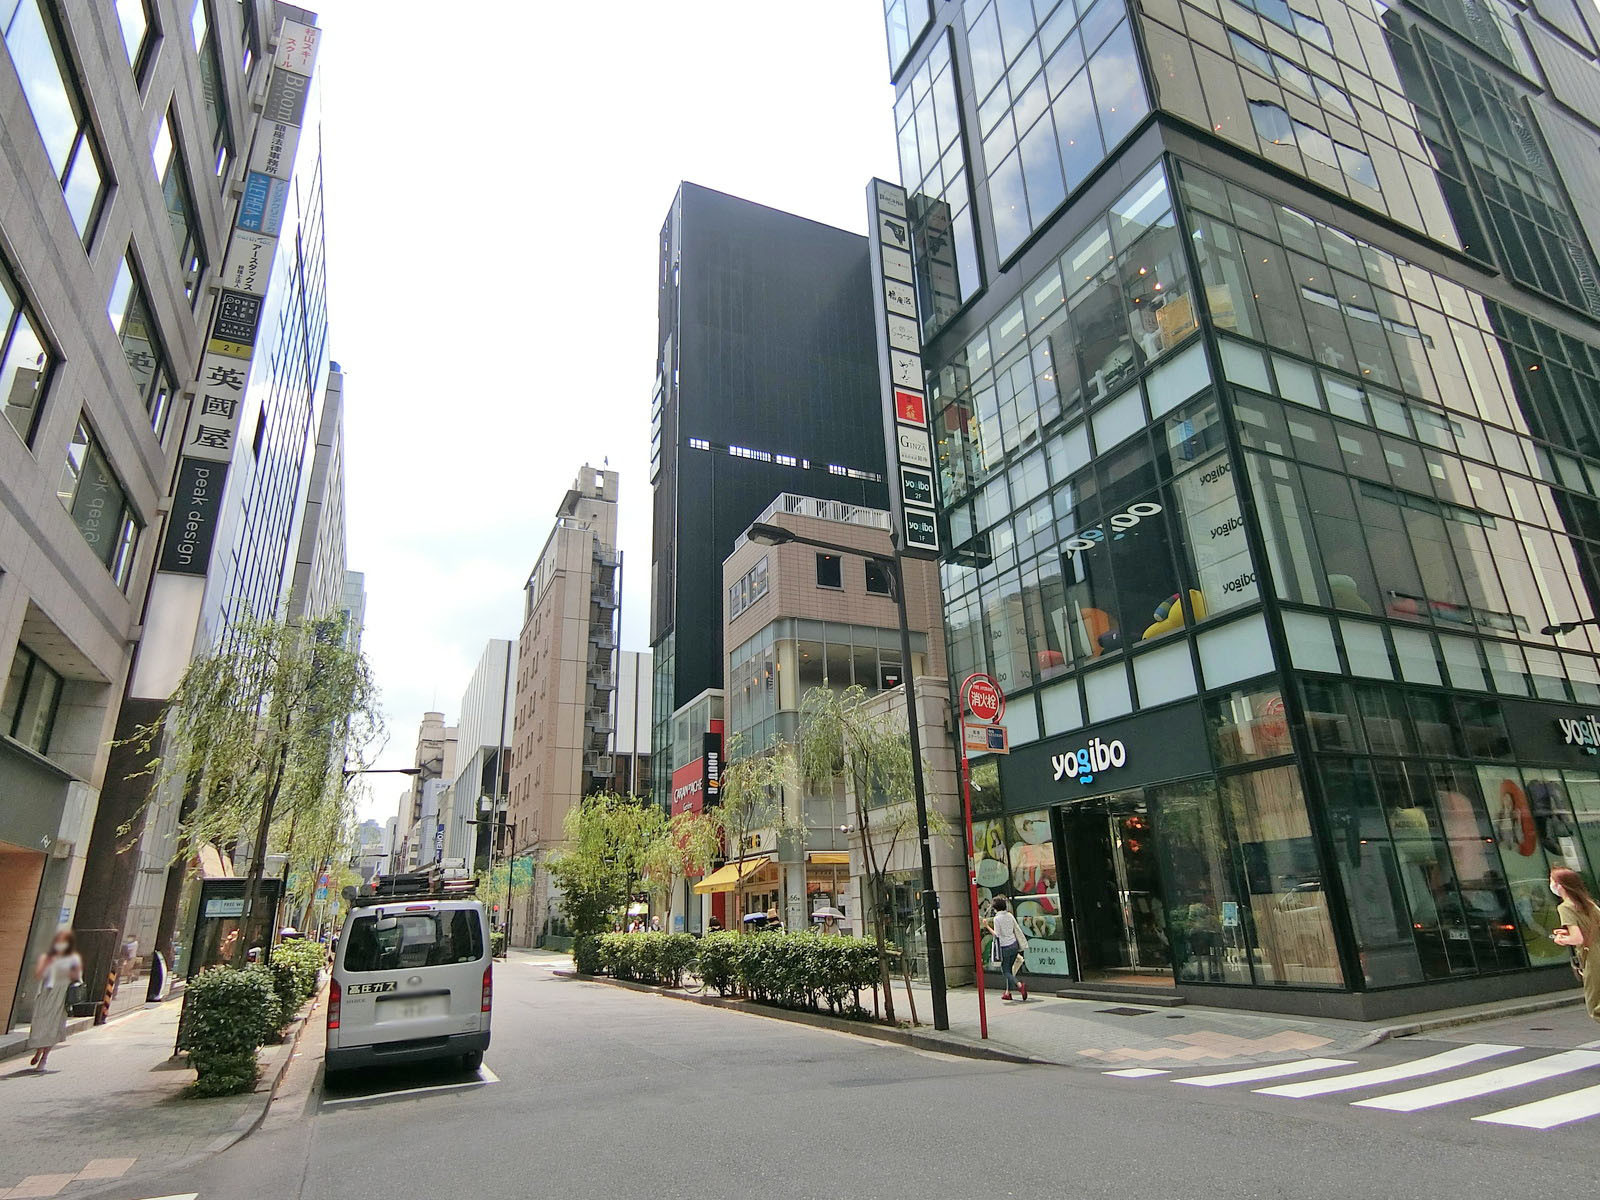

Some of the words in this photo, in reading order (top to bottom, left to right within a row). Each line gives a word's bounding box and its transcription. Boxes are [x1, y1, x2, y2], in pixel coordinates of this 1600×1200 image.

[282, 38, 297, 68] スクール
[277, 74, 305, 121] Bloom
[265, 123, 287, 175] 銀座法律事務所
[243, 219, 259, 228] 4F
[244, 243, 262, 292] アースタックス
[225, 304, 255, 315] LIFE
[220, 328, 251, 337] GALLERY
[190, 365, 245, 451] 英國屋
[192, 467, 211, 506] peak
[914, 492, 922, 500] 2F
[178, 511, 206, 566] design
[918, 535, 926, 543] 1F
[970, 691, 997, 710] 消火栓
[707, 752, 720, 795] DOUTOR
[1052, 737, 1126, 785] yogibo
[349, 982, 395, 994] 高圧ガス
